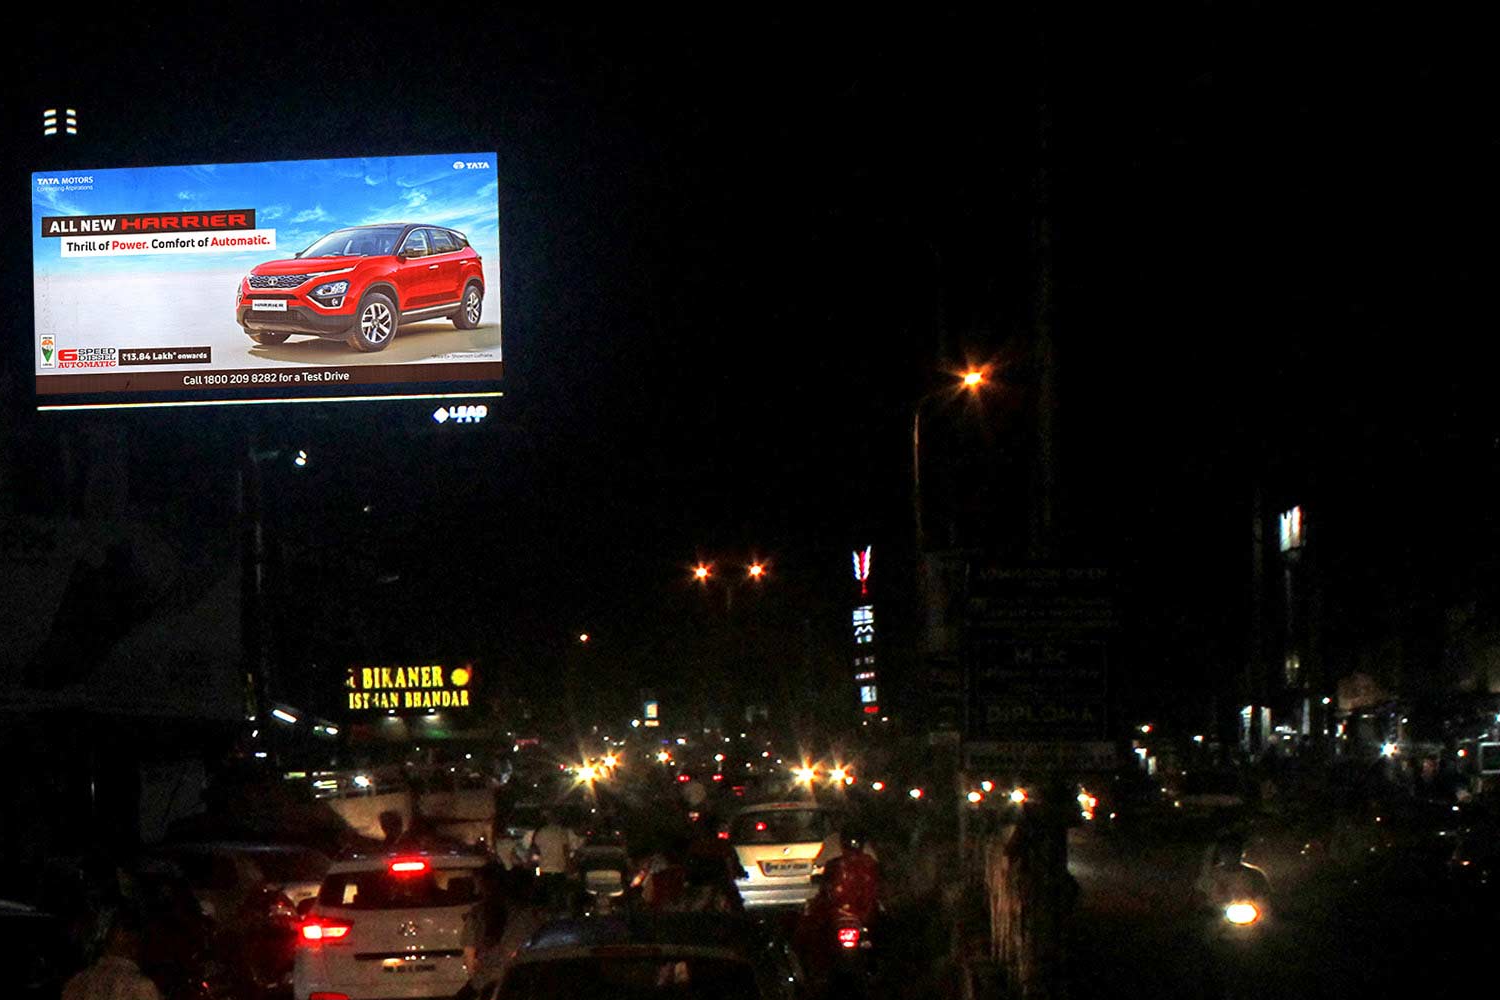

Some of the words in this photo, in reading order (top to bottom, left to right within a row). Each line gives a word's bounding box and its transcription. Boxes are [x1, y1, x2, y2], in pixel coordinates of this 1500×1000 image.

[62, 176, 94, 184] MOTORS
[49, 221, 77, 233] ALL
[81, 219, 117, 232] NEW
[121, 214, 247, 230] HARRIER
[67, 241, 96, 252] Thrill
[99, 241, 110, 251] of
[112, 240, 149, 250] Power.
[151, 238, 195, 249] Comfort
[198, 237, 209, 247] of
[211, 235, 270, 246] Automatic.
[58, 348, 78, 361] 6
[177, 352, 207, 360] onwards
[183, 376, 202, 385] Call
[204, 375, 228, 384] 1800
[230, 374, 249, 384] 209
[251, 373, 277, 383] 8282
[279, 373, 293, 382] for
[294, 374, 301, 382] a
[302, 372, 322, 381] Test
[324, 371, 350, 381] Drive
[362, 666, 444, 688] BIKANER
[405, 690, 469, 708] BHANDAR
